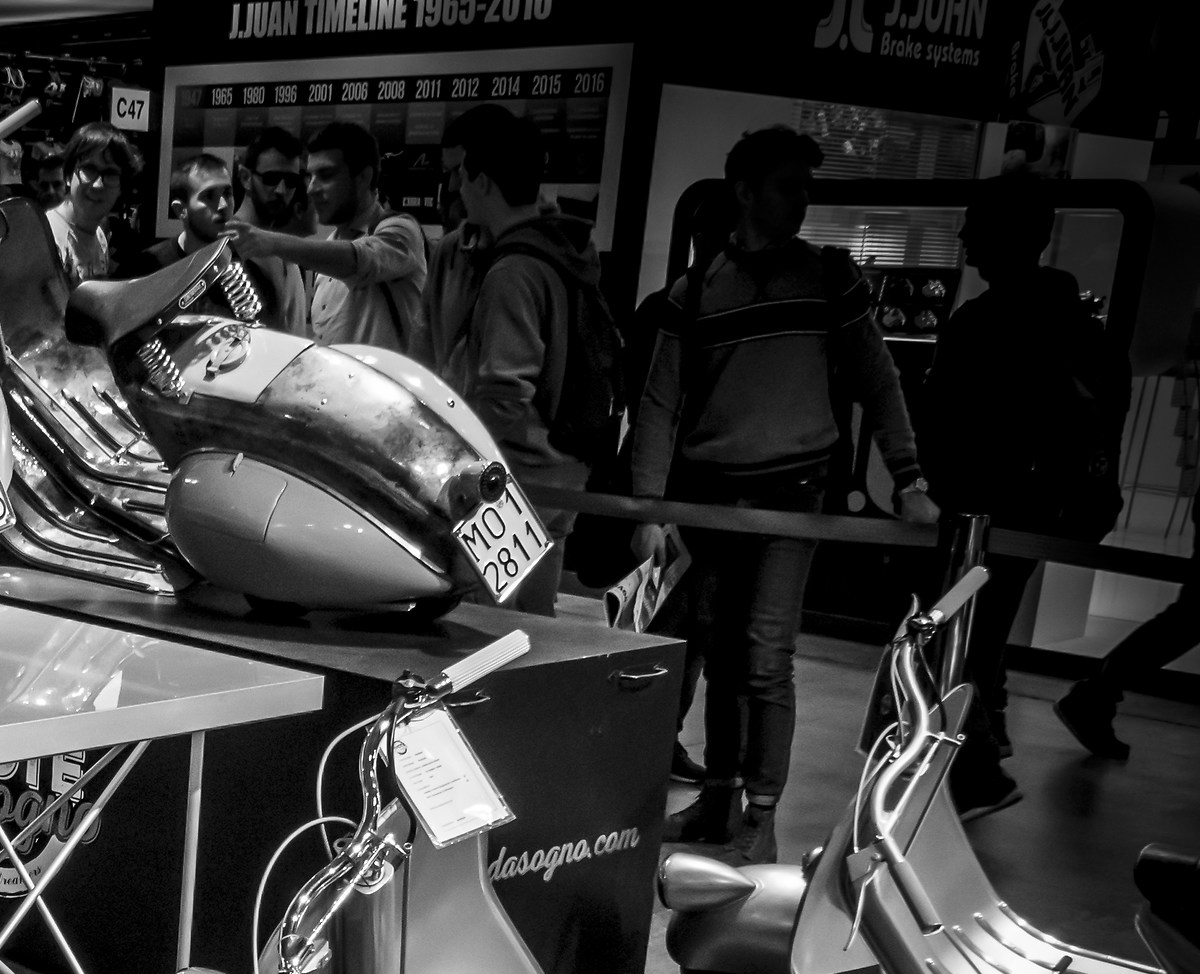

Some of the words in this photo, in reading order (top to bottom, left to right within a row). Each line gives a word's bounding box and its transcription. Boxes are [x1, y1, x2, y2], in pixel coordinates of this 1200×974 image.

[304, 0, 407, 35] TIMELINE
[880, 31, 921, 60] Brake
[926, 41, 980, 68] systems
[211, 87, 233, 106] 1965
[242, 86, 265, 104] 1980
[274, 84, 297, 104] 1996
[307, 83, 333, 103] 2001
[341, 81, 369, 101] 2006
[377, 80, 405, 100] 2008
[415, 79, 442, 99] 2011
[451, 77, 480, 98] 2012
[491, 75, 521, 97] 2014
[532, 74, 561, 95] 2015
[574, 72, 605, 94] 2016
[116, 97, 144, 120] C47
[461, 507, 506, 562] MO
[483, 521, 542, 592] 2811
